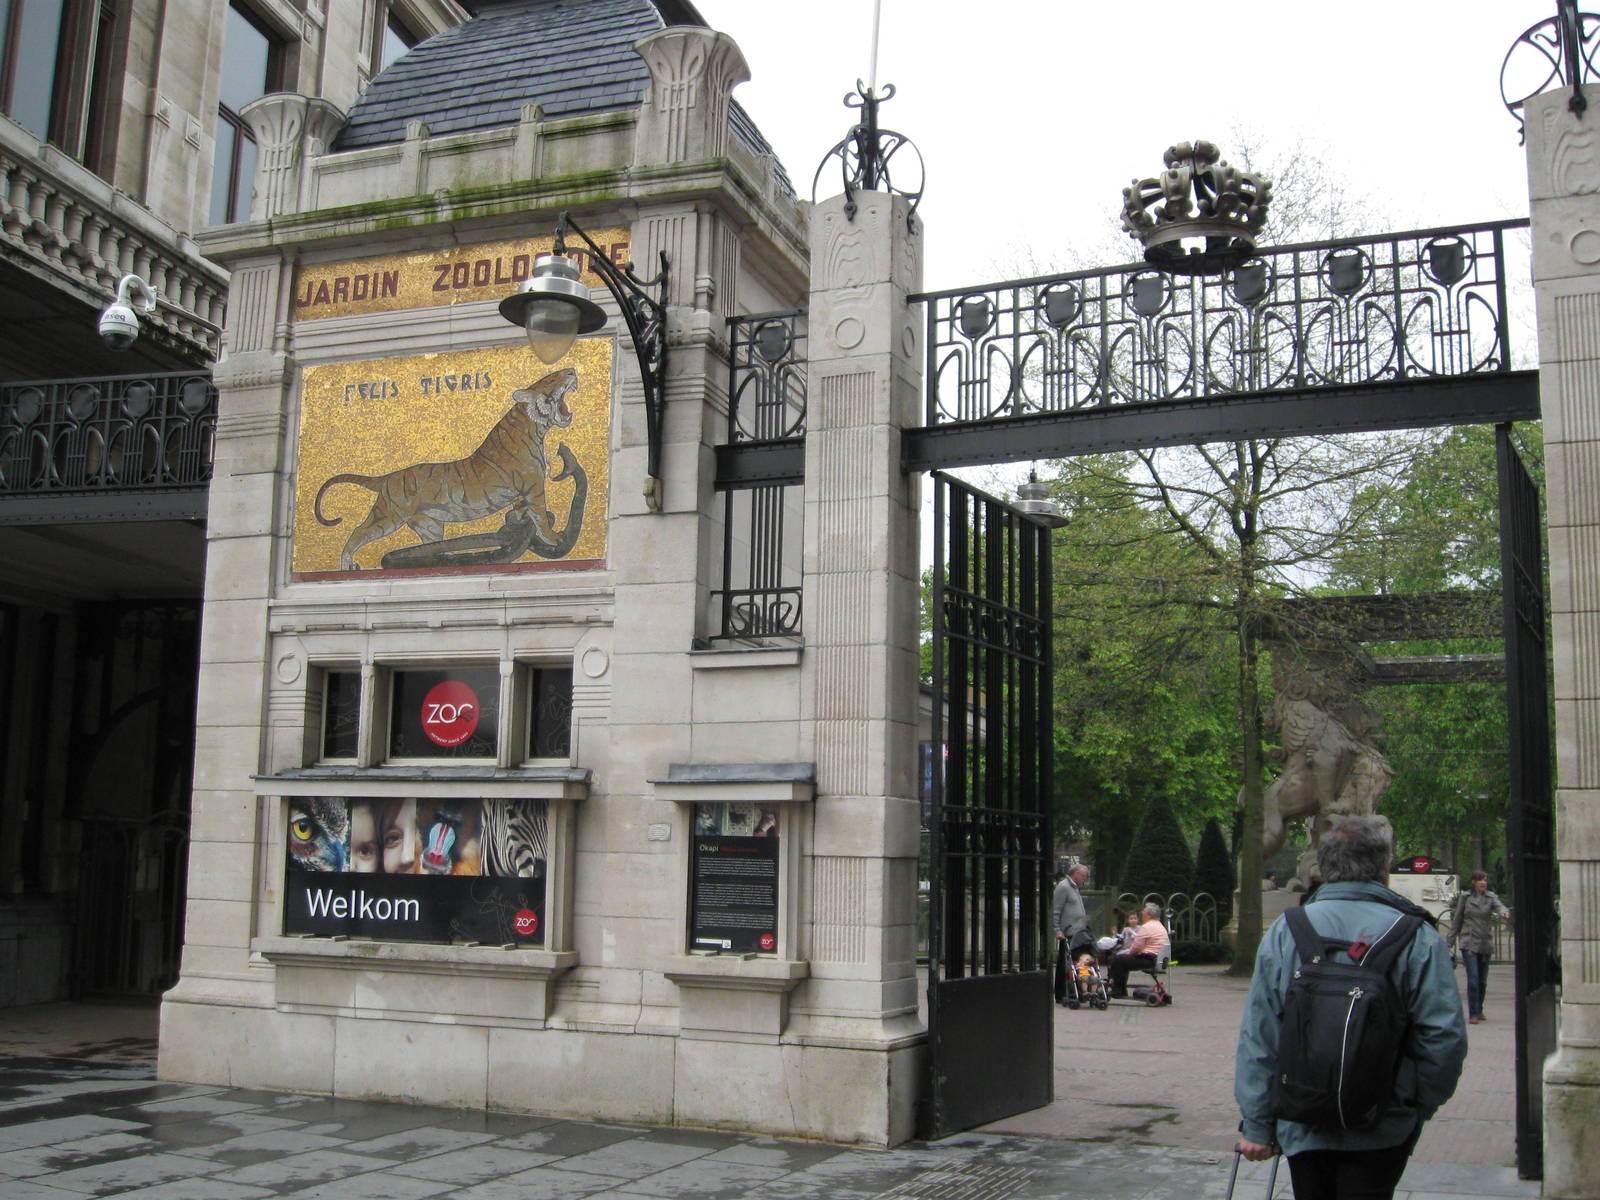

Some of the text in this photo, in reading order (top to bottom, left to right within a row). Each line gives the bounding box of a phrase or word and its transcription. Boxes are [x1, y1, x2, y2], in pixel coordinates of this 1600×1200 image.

[295, 242, 629, 307] JARDIN ZOOLOE
[344, 371, 493, 401] FELIS TIGRIS
[306, 888, 420, 921] Welkom
